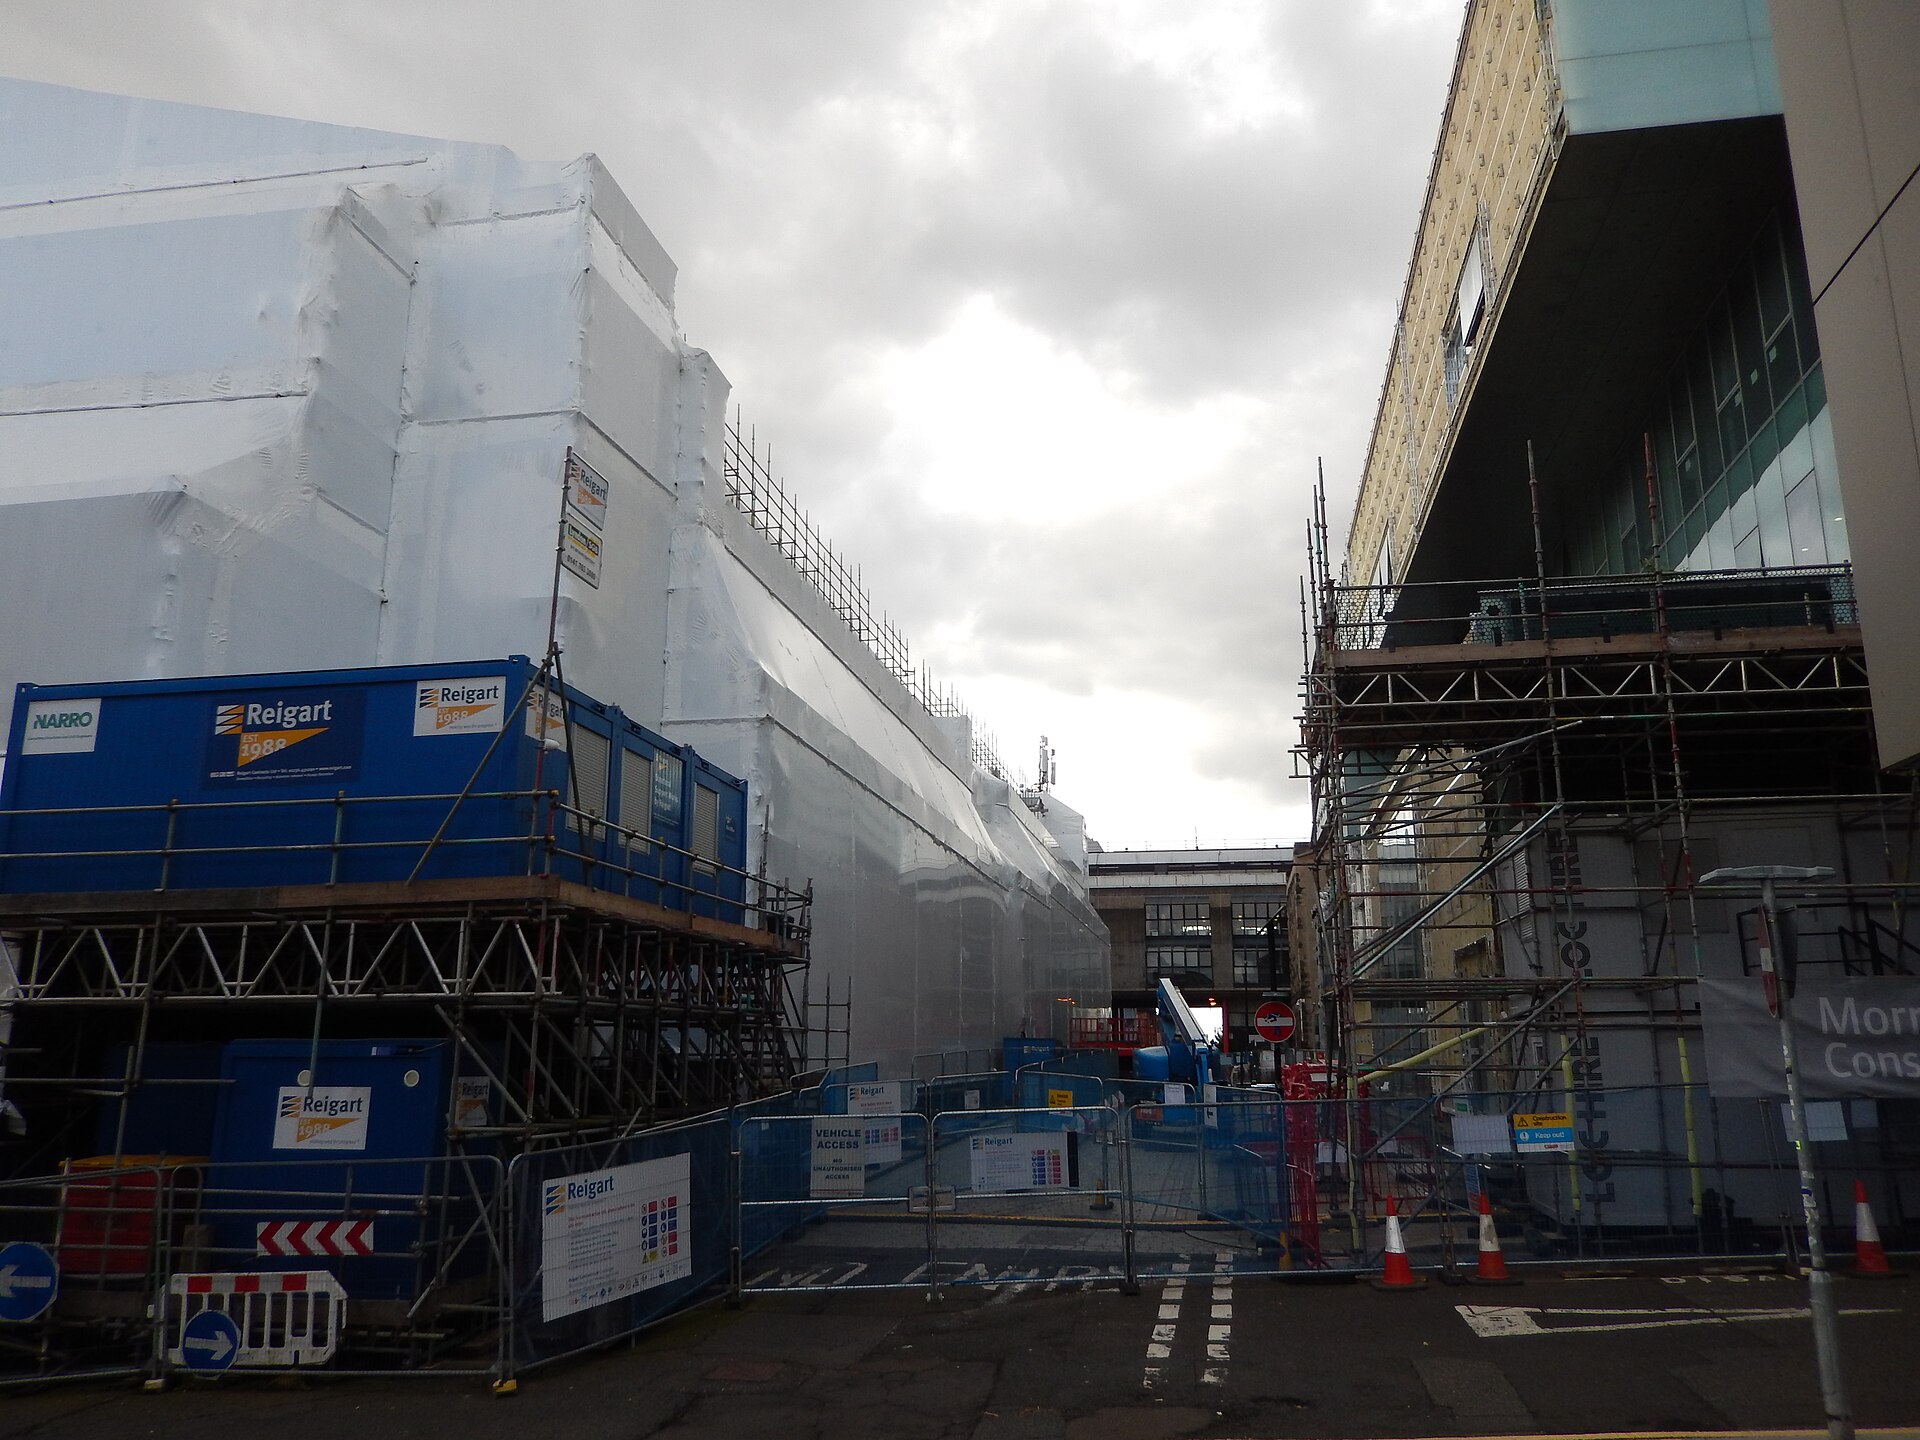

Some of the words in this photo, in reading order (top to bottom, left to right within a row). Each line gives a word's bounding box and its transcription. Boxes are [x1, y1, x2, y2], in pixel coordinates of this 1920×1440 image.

[580, 469, 607, 500] Reigart
[441, 685, 499, 704] Reigart
[33, 712, 93, 729] NARRO
[247, 700, 333, 728] Reigart
[438, 710, 469, 725] 1988
[243, 734, 259, 742] EST
[240, 739, 287, 761] 1988
[462, 1082, 488, 1098] Reigart
[860, 1086, 884, 1096] Reigart
[303, 1095, 362, 1116] Reigart
[299, 1122, 331, 1138] 1988
[816, 1129, 861, 1137] VEHICLE
[1535, 1131, 1552, 1139] Keep
[817, 1141, 859, 1149] ACCESS
[984, 1137, 1013, 1146] Reigart
[568, 1175, 614, 1200] Reigart
